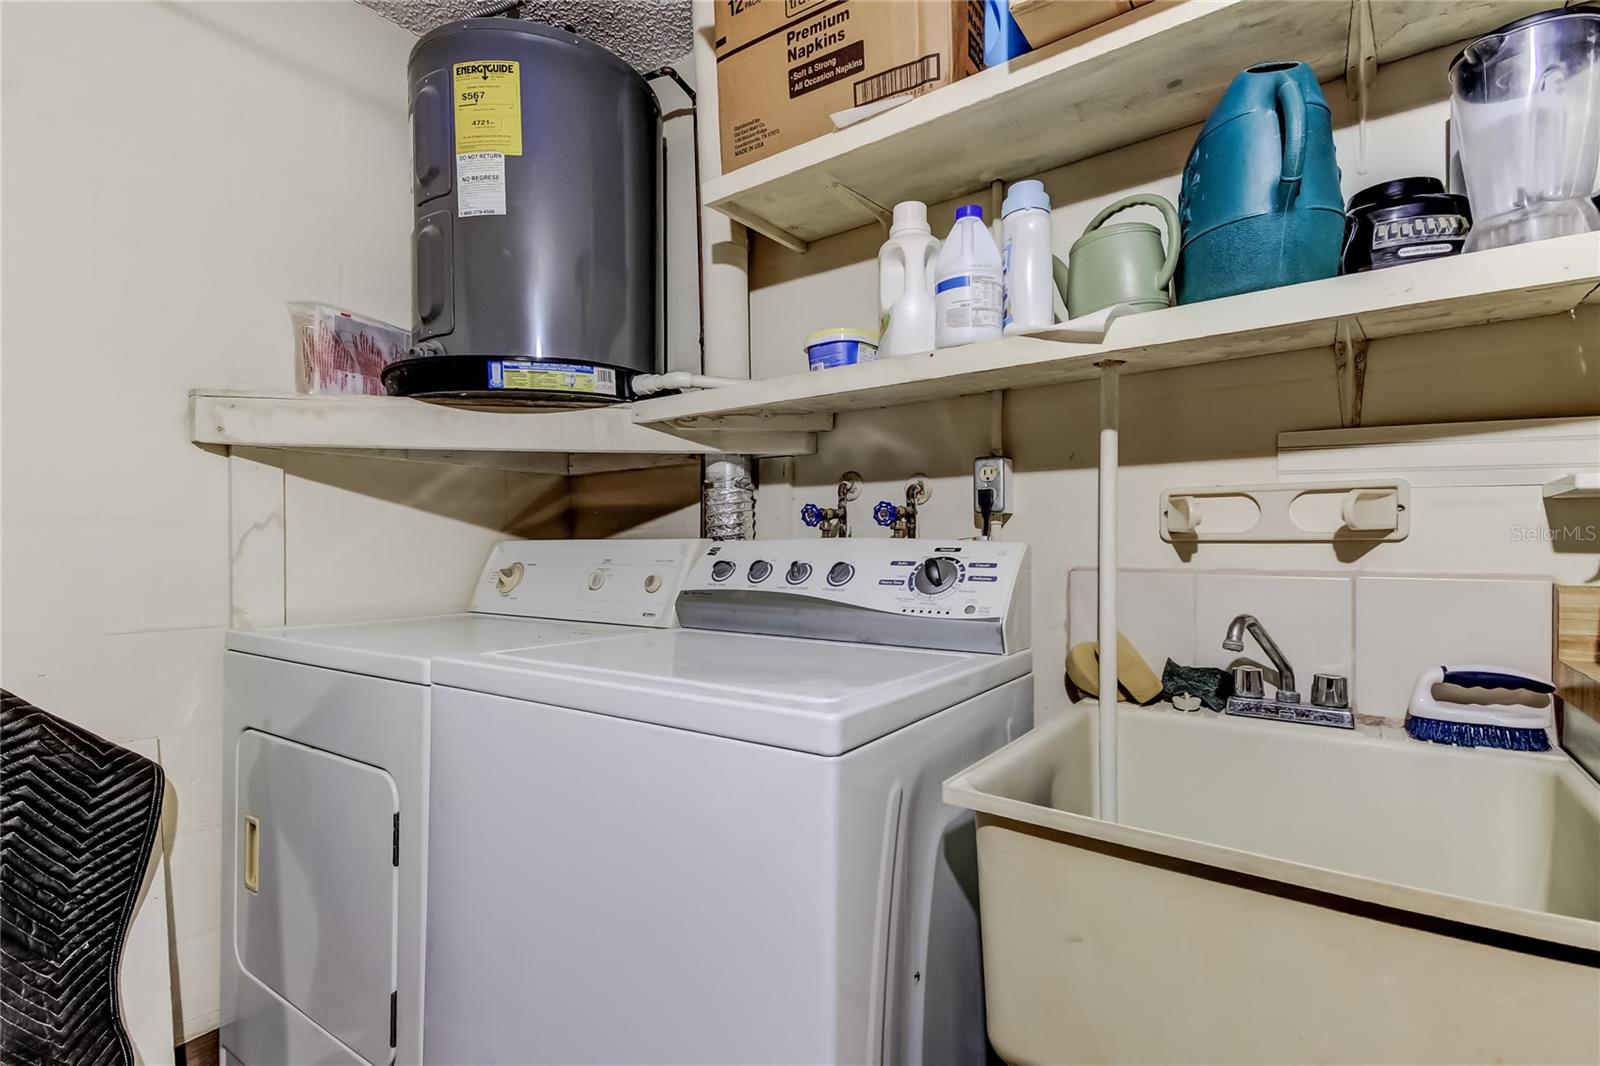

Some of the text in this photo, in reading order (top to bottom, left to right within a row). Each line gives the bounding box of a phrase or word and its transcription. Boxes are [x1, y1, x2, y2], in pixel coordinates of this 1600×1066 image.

[786, 9, 850, 46] Premium
[787, 29, 846, 63] Napkins
[456, 64, 514, 77] ENERGYGUIDE
[793, 68, 807, 80] Soft
[814, 58, 837, 72] Strong
[794, 58, 863, 91] All Occasion Napkins
[461, 91, 485, 101] $567
